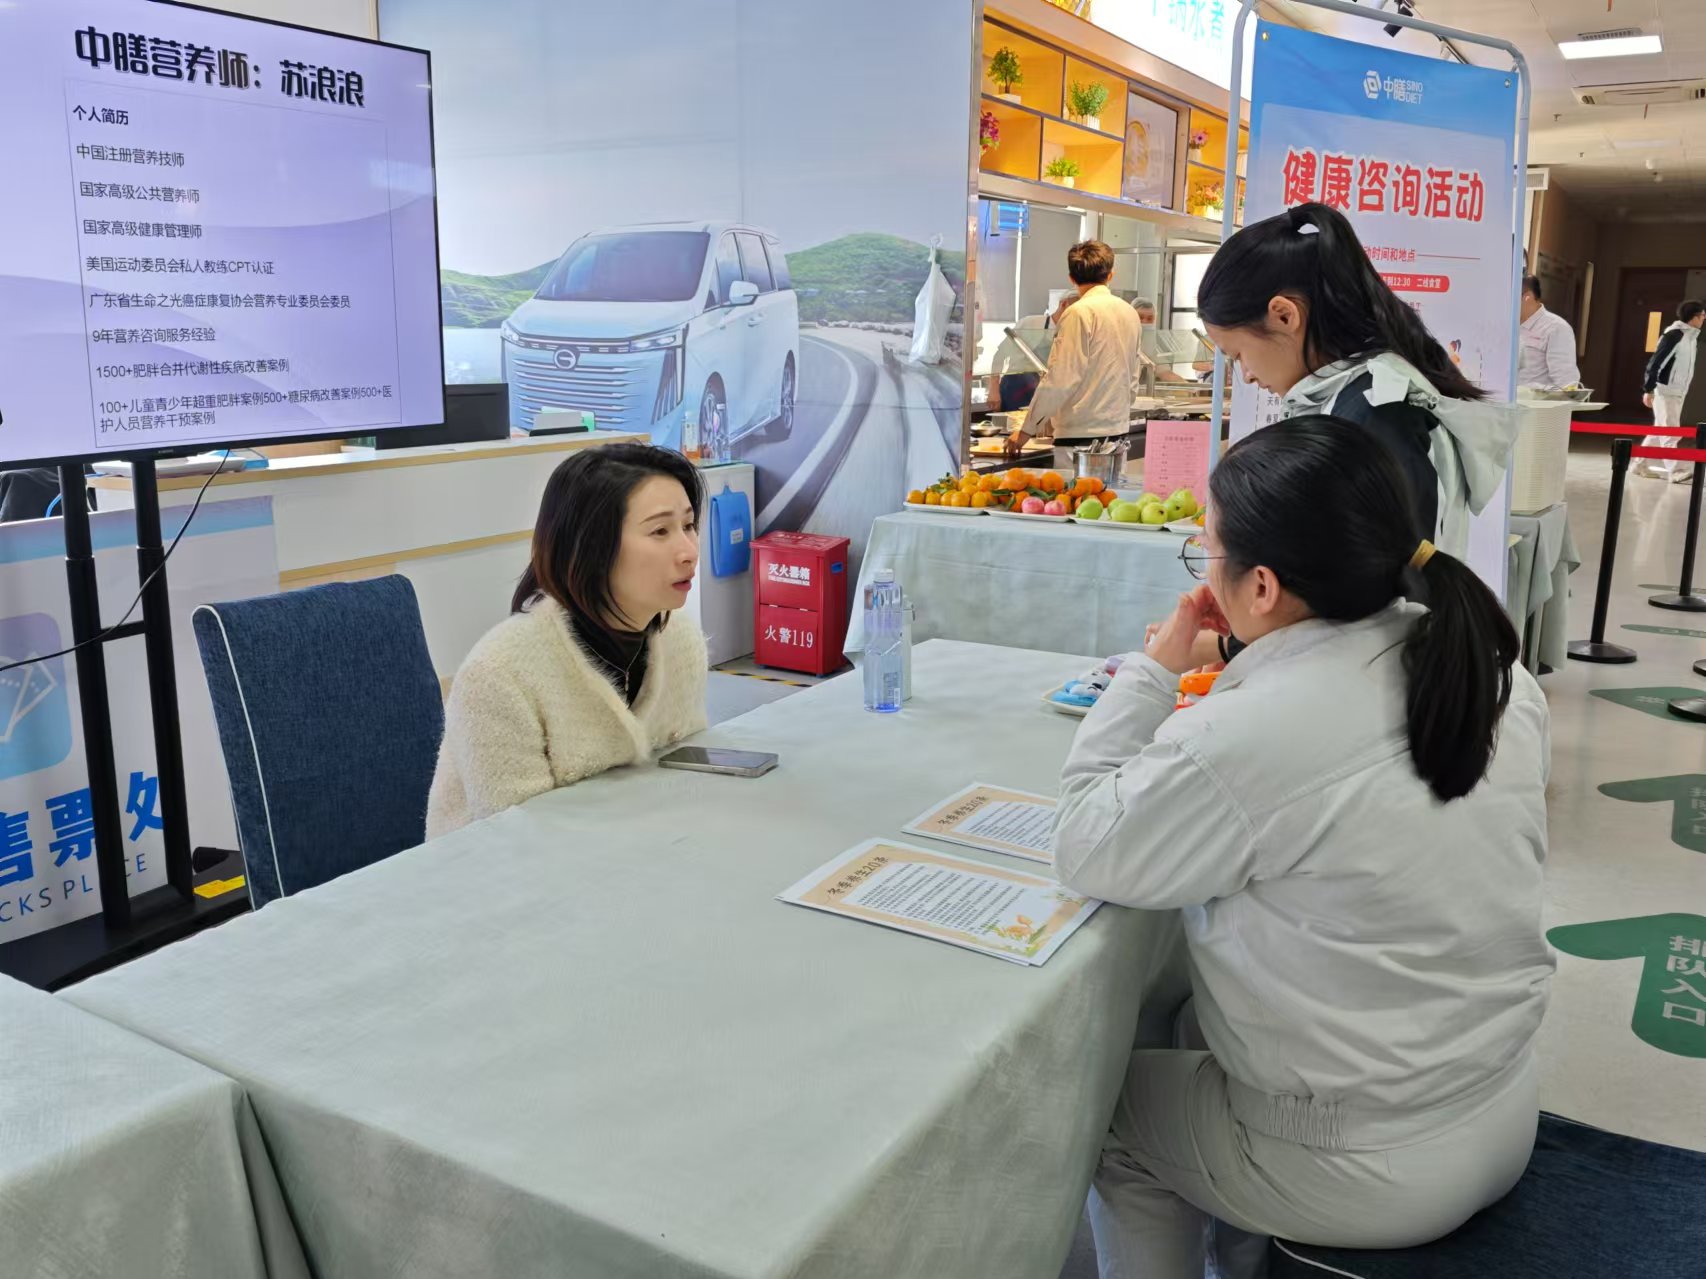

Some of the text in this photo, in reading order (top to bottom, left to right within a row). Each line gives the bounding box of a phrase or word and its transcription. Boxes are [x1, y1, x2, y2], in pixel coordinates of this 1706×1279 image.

[1406, 92, 1422, 105] DIET
[73, 105, 129, 125] 个人简历
[76, 143, 185, 168] 中国注册营养技师
[79, 181, 200, 204] 国家高级公共营养师
[1283, 150, 1485, 222] 健康咨询活动
[83, 219, 202, 239] 国家高级健康管理师
[86, 256, 275, 275] 美国运动委员会私人教练CPT认证
[89, 293, 351, 309] 广东省生命之光癌症康复协会营养专业委员会委员
[92, 328, 216, 344] 9年营养咨询服务经验
[96, 358, 289, 379] 1500+肥胖合并代谢性疾病改善案例
[99, 385, 392, 415] 100+儿童青少年超重肥胖案例500+糖尿病改善案例500+医
[100, 410, 216, 433] 护人员营养干预案例
[768, 562, 811, 580] 灭火器箱
[764, 624, 814, 649] 火警119
[63, 853, 148, 900] PLE
